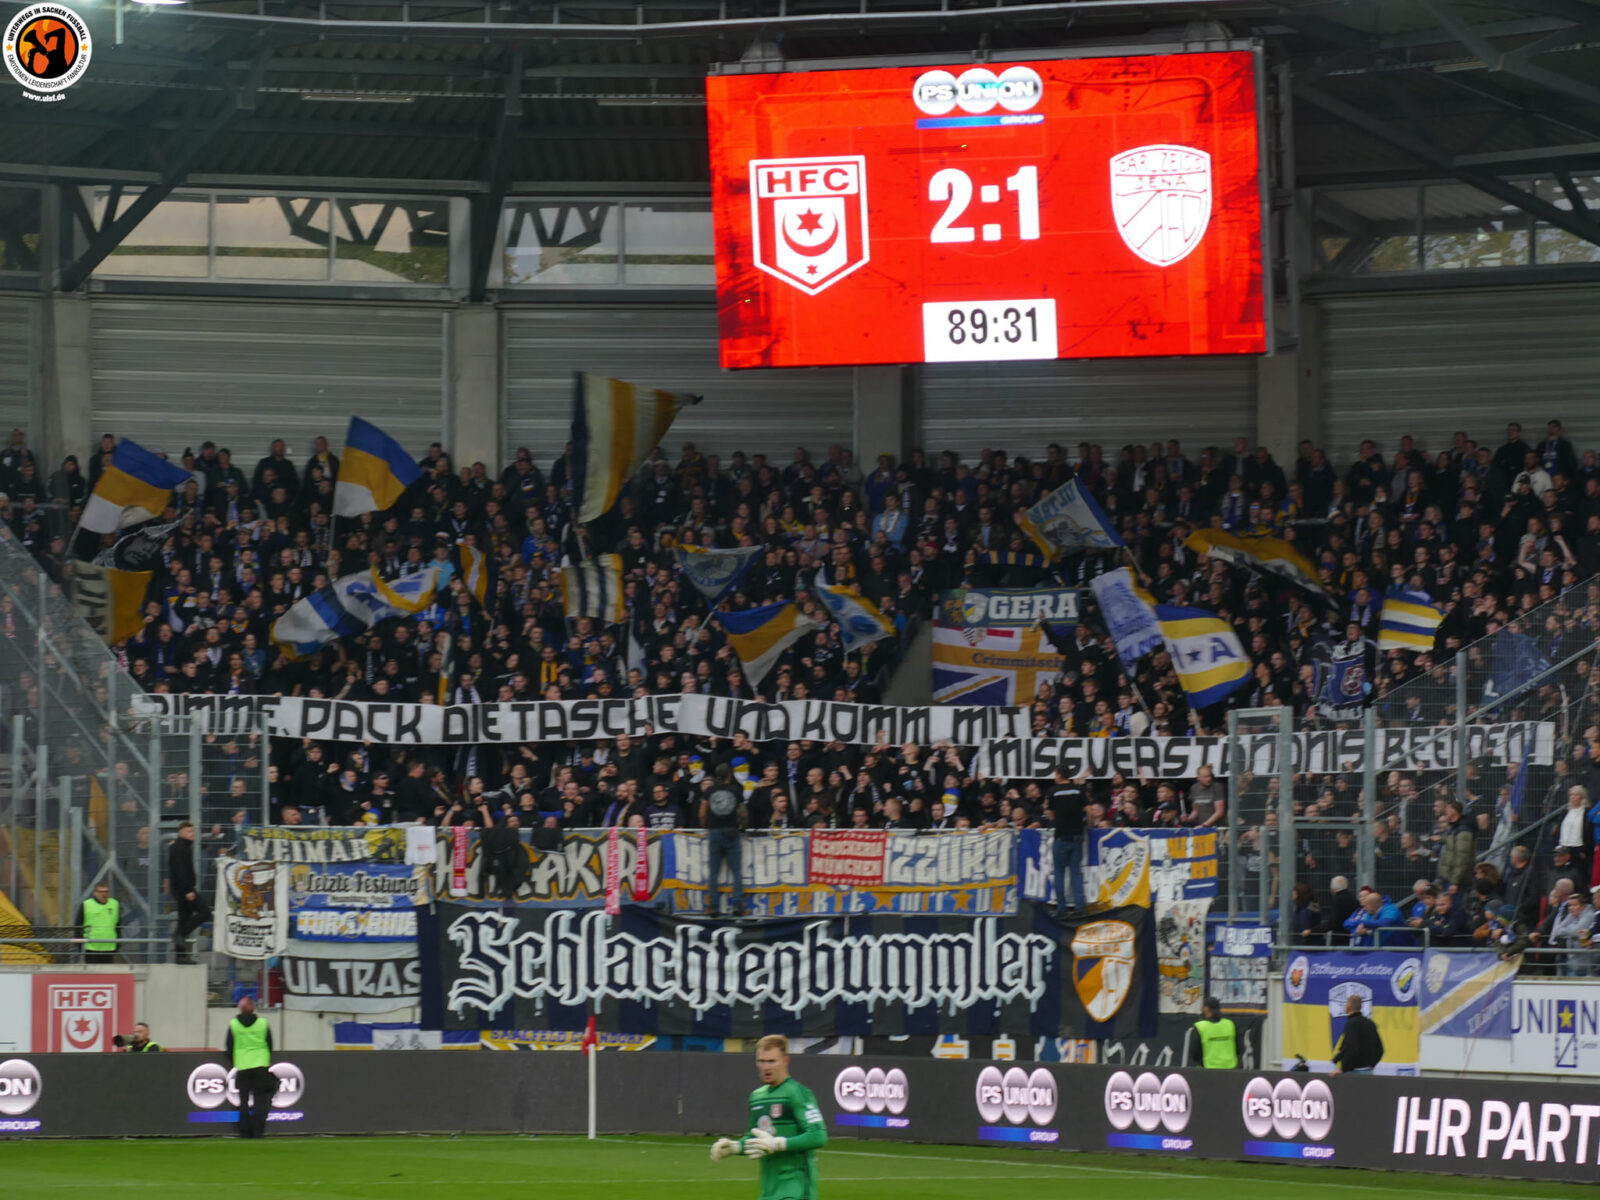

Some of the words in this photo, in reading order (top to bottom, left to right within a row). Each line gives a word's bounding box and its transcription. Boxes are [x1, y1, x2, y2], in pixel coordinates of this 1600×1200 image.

[920, 85, 953, 101] PS
[957, 81, 1034, 99] UNION
[766, 166, 850, 194] HFC
[928, 165, 1040, 244] 2:1
[948, 306, 1038, 345] 89:31
[988, 592, 1079, 620] GERA
[300, 699, 422, 744] PACK
[442, 702, 504, 744] DIE
[511, 695, 681, 742] TASCHE
[803, 700, 930, 745] KOMM
[952, 705, 1023, 746] MIT
[241, 835, 372, 864] WEIMAR
[306, 870, 352, 893] Letzte
[353, 870, 420, 897] Festung
[900, 890, 950, 913] MIT
[975, 887, 1018, 914] UNS
[447, 909, 1056, 1012] Schlachtenbummler
[285, 959, 421, 997] ULTRAS
[57, 990, 108, 1008] HFC
[194, 1079, 225, 1094] PS
[841, 1082, 866, 1098] PS
[866, 1083, 904, 1099] UNION
[981, 1085, 1003, 1104] PS
[1004, 1086, 1052, 1107] UNION
[1110, 1090, 1132, 1110] PS
[1133, 1092, 1186, 1113] UNION
[1247, 1097, 1271, 1117] PS
[1272, 1099, 1329, 1121] UNION
[886, 1118, 910, 1128] GROUP
[1393, 1095, 1472, 1158] IHR
[1476, 1099, 1600, 1165] PART
[1030, 1130, 1059, 1142] GROUP
[1162, 1138, 1193, 1150] GROUP
[1302, 1147, 1336, 1160] GROUP
